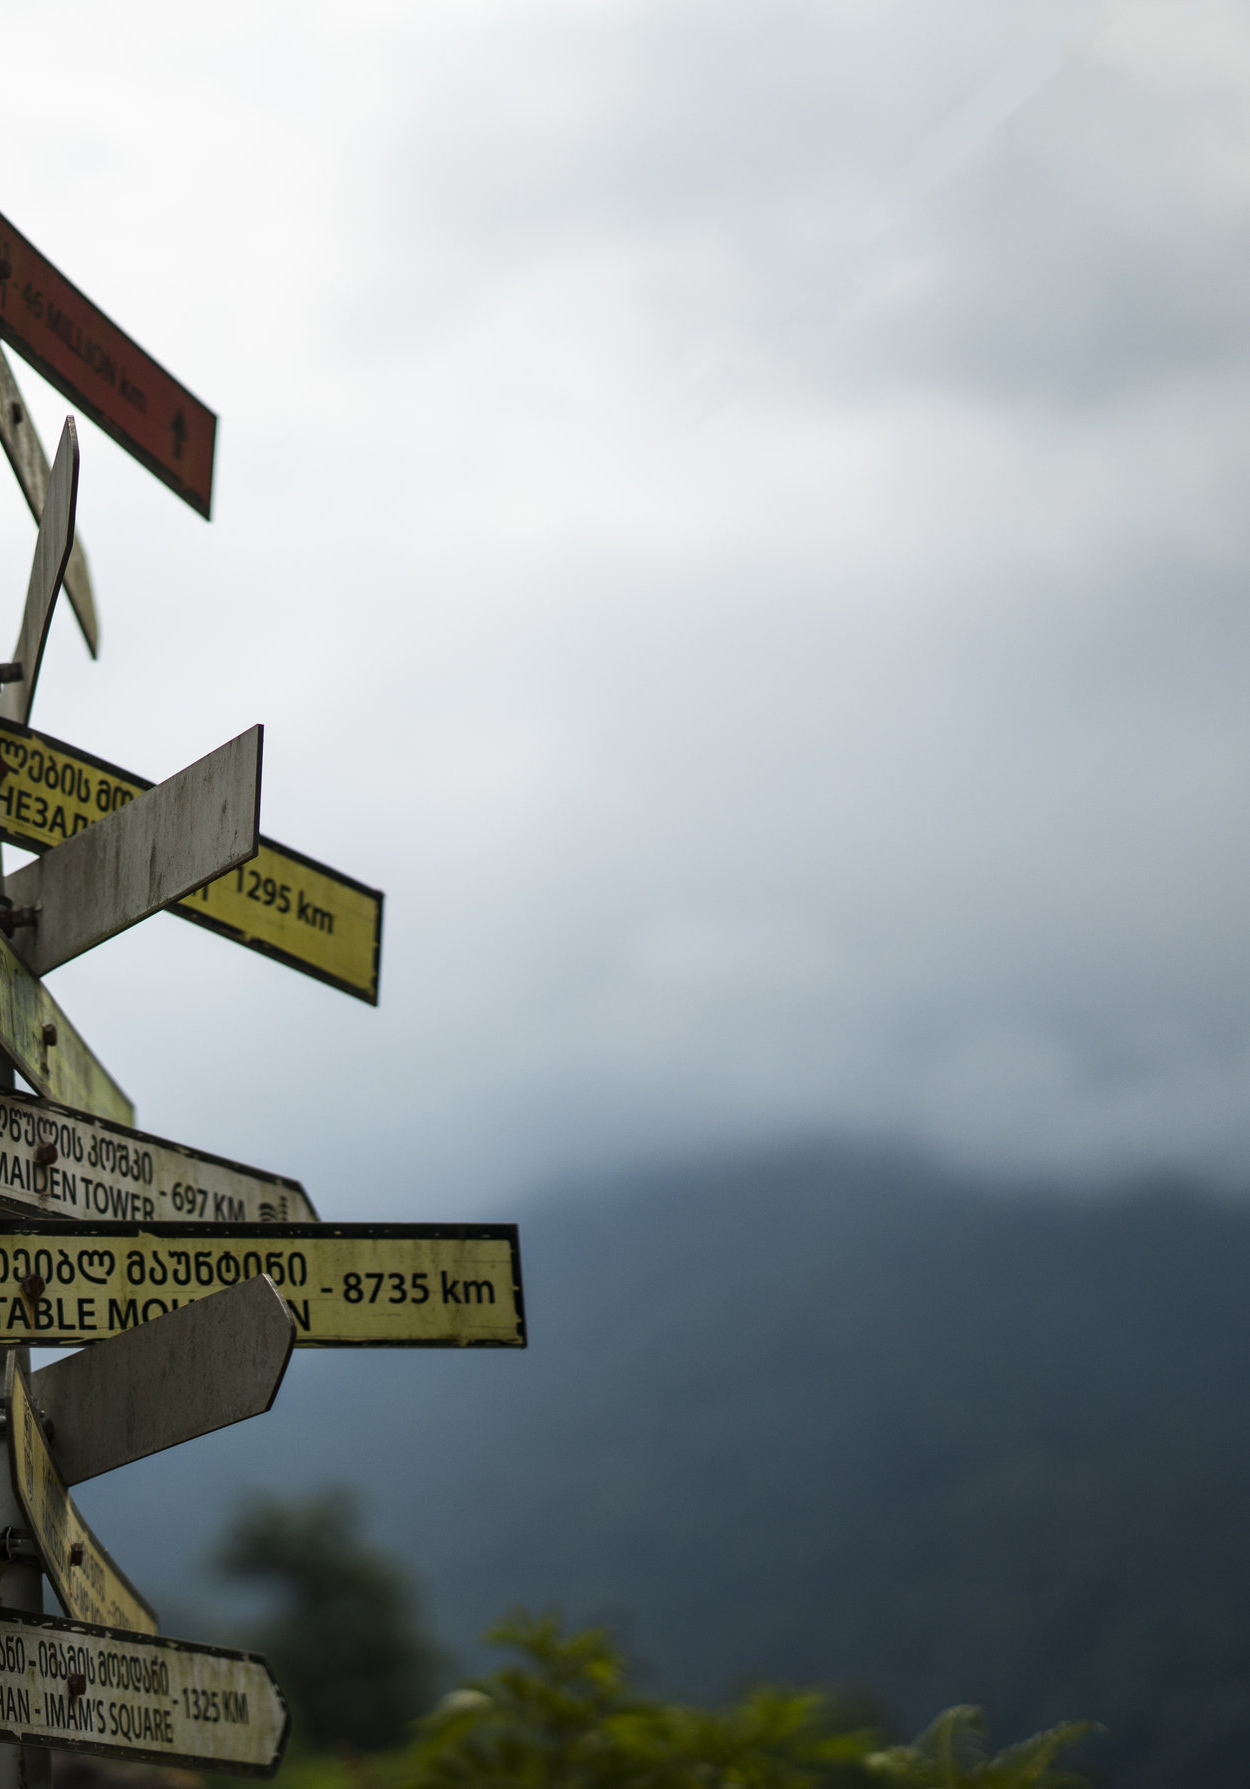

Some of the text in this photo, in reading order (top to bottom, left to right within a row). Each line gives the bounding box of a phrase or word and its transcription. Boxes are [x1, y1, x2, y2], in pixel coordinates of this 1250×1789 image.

[236, 866, 334, 934] 1295 km
[80, 1176, 155, 1220] TOWER
[172, 1182, 208, 1218] 697
[213, 1192, 246, 1221] KM
[342, 1272, 430, 1304] 8735
[441, 1271, 496, 1305] km
[109, 1701, 174, 1743] SQUARE
[183, 1687, 220, 1722] 1325
[221, 1690, 249, 1724] KM
